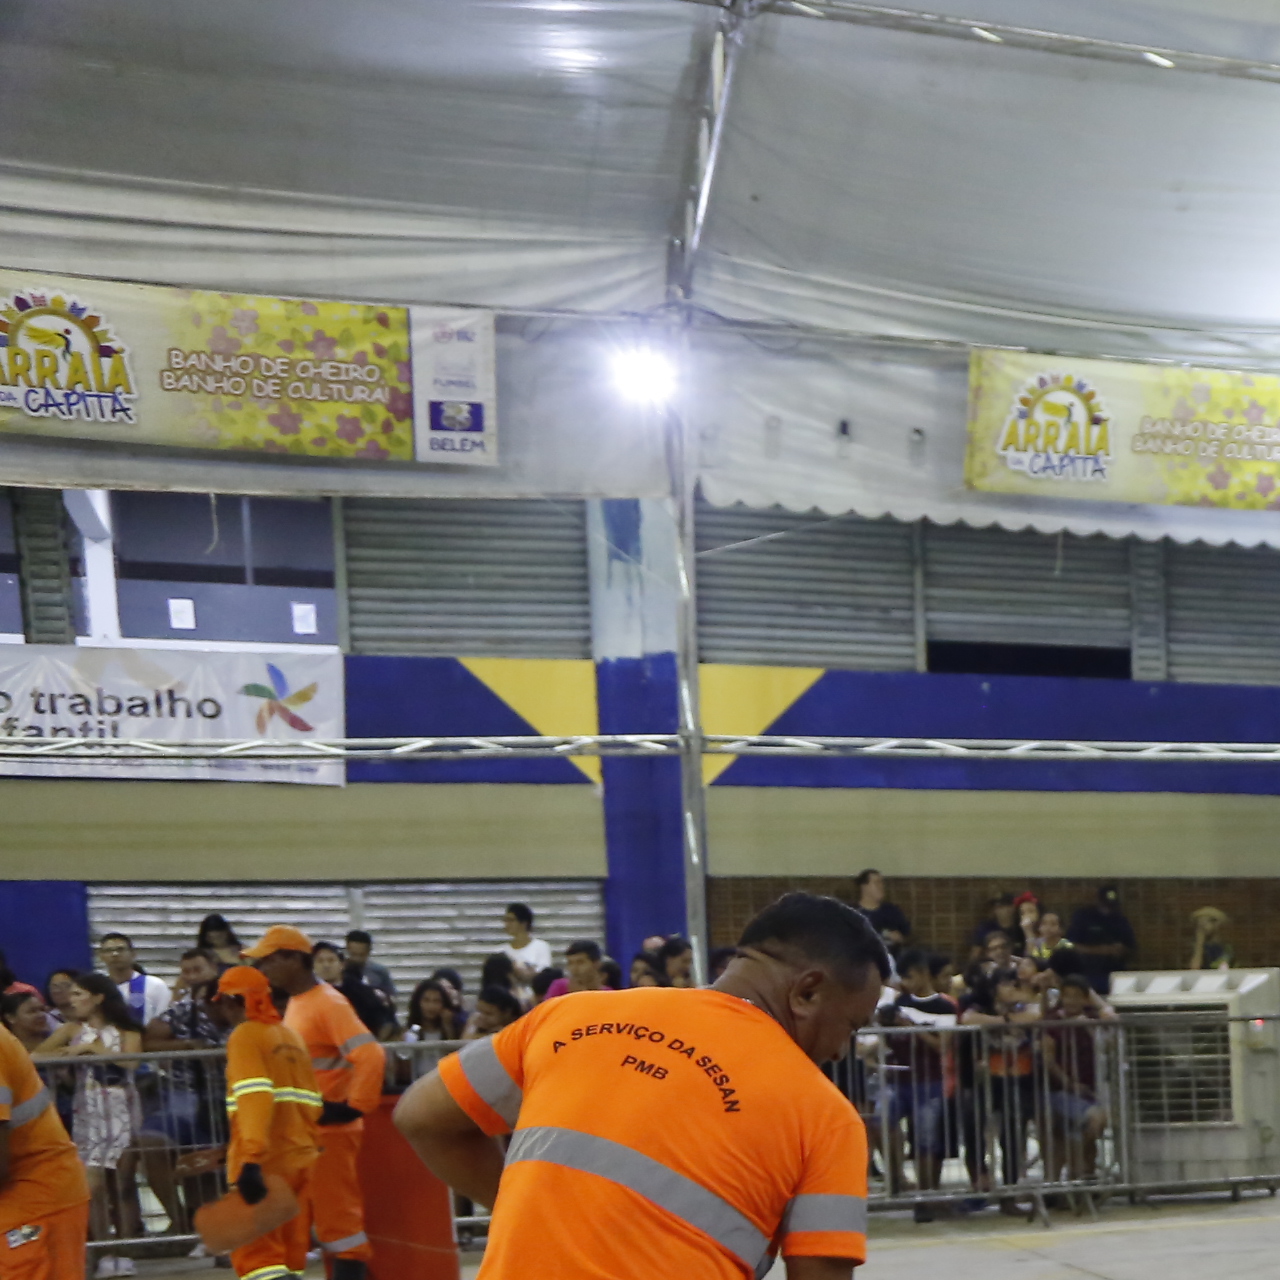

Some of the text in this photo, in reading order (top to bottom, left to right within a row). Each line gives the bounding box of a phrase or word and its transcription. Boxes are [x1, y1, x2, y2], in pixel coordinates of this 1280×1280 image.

[170, 350, 253, 376] BANHO
[260, 358, 289, 377] DE
[163, 371, 246, 396] BANHO
[252, 378, 281, 398] DE
[1141, 416, 1201, 437] BANHO
[1206, 423, 1228, 438] DE
[1132, 434, 1195, 455] BANHO
[1201, 441, 1219, 457] DE
[30, 686, 222, 719] trabalho
[552, 1022, 741, 1113] A SERVIÇO DA SESAN
[621, 1055, 669, 1080] PMB
